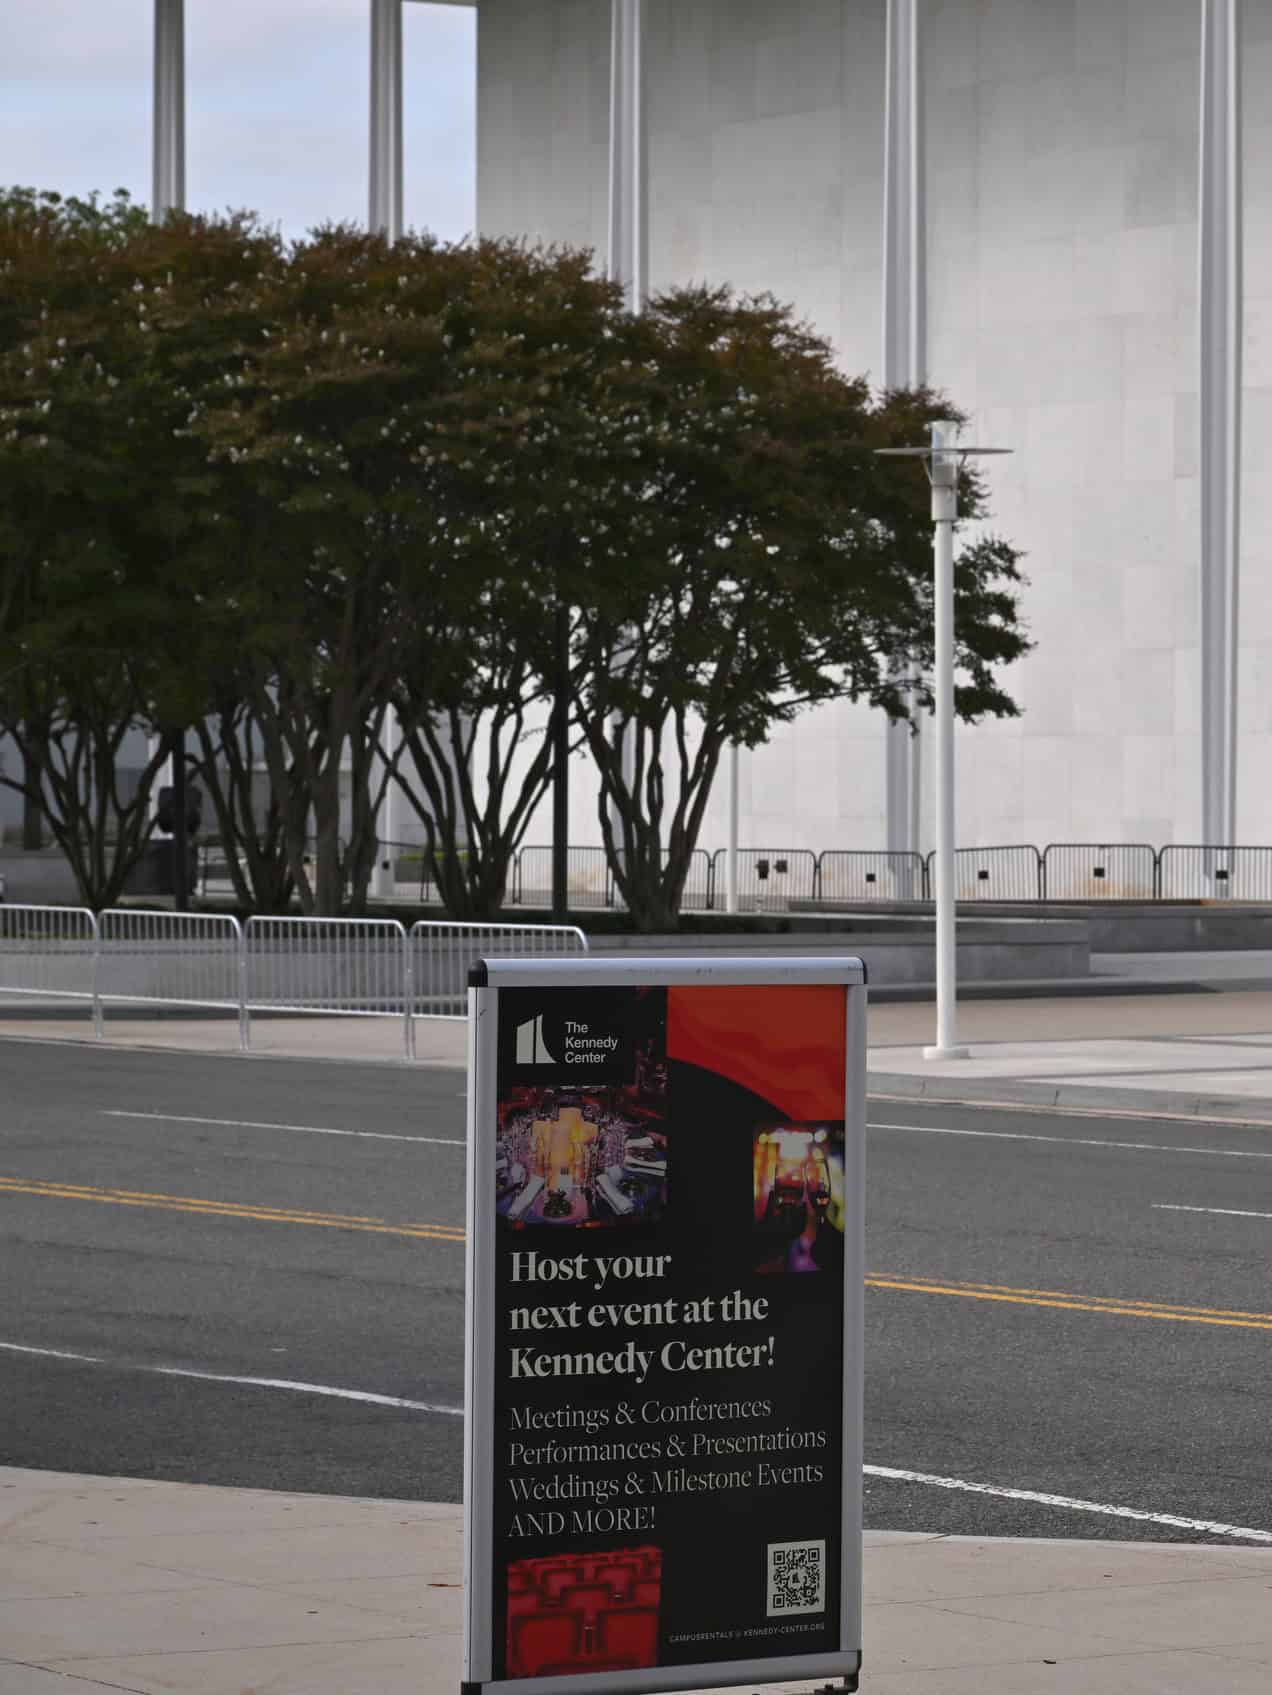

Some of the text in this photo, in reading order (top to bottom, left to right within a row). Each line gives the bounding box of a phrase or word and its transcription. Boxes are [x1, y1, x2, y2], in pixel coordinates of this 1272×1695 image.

[565, 1021, 588, 1033] The
[565, 1036, 618, 1051] Kennedy
[565, 1052, 606, 1063] Center
[509, 1251, 671, 1290] Host your
[509, 1289, 768, 1330] next event at the
[509, 1336, 775, 1383] Kennedy Center!
[509, 1397, 771, 1434] Meetings & Conferences
[508, 1426, 826, 1466] Performances & Presentations
[508, 1463, 824, 1504] Weddings & Milestone Events
[508, 1506, 656, 1537] AND MORE!
